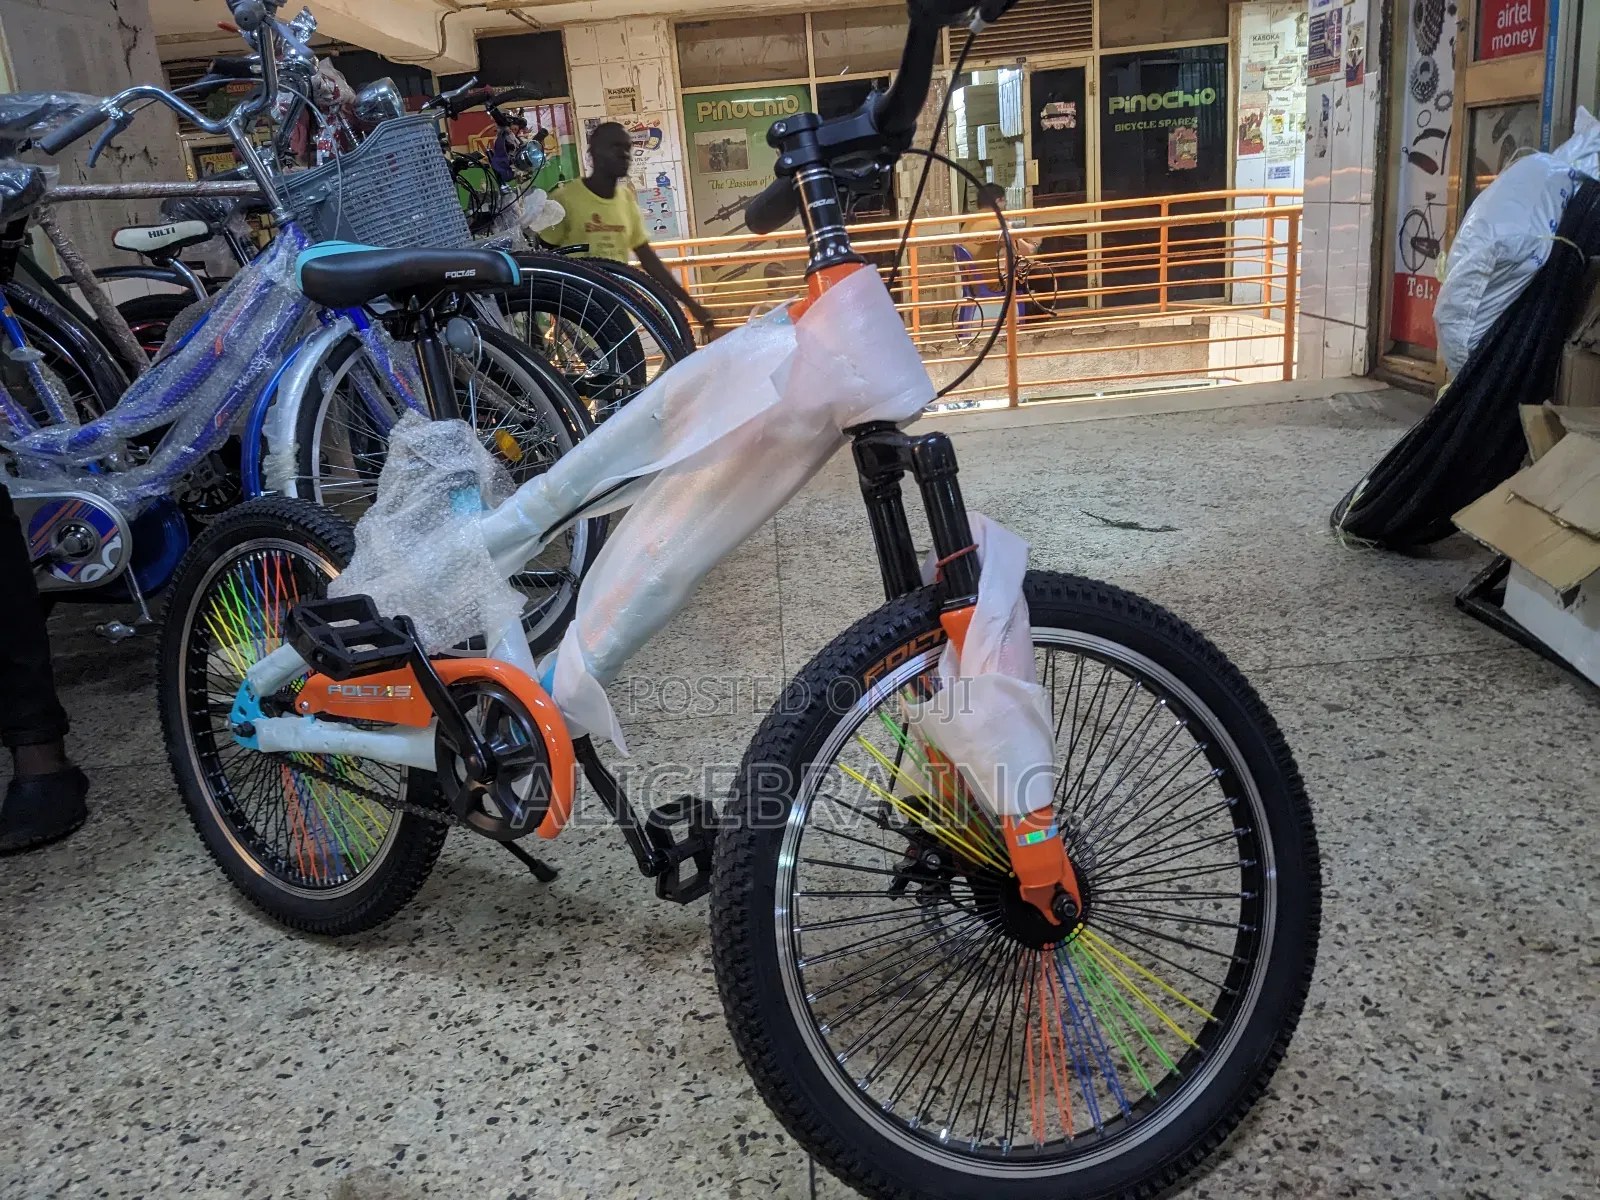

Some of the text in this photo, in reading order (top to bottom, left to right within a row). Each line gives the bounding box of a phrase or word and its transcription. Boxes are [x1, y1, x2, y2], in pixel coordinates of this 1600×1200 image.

[1497, 0, 1532, 29] airtel
[1491, 26, 1538, 51] money
[1114, 117, 1198, 133] BICYCLE SPARES
[708, 179, 725, 190] The
[726, 178, 759, 190] Passion
[760, 175, 769, 188] of
[148, 227, 175, 239] HILTI
[1407, 277, 1434, 300] Tel:
